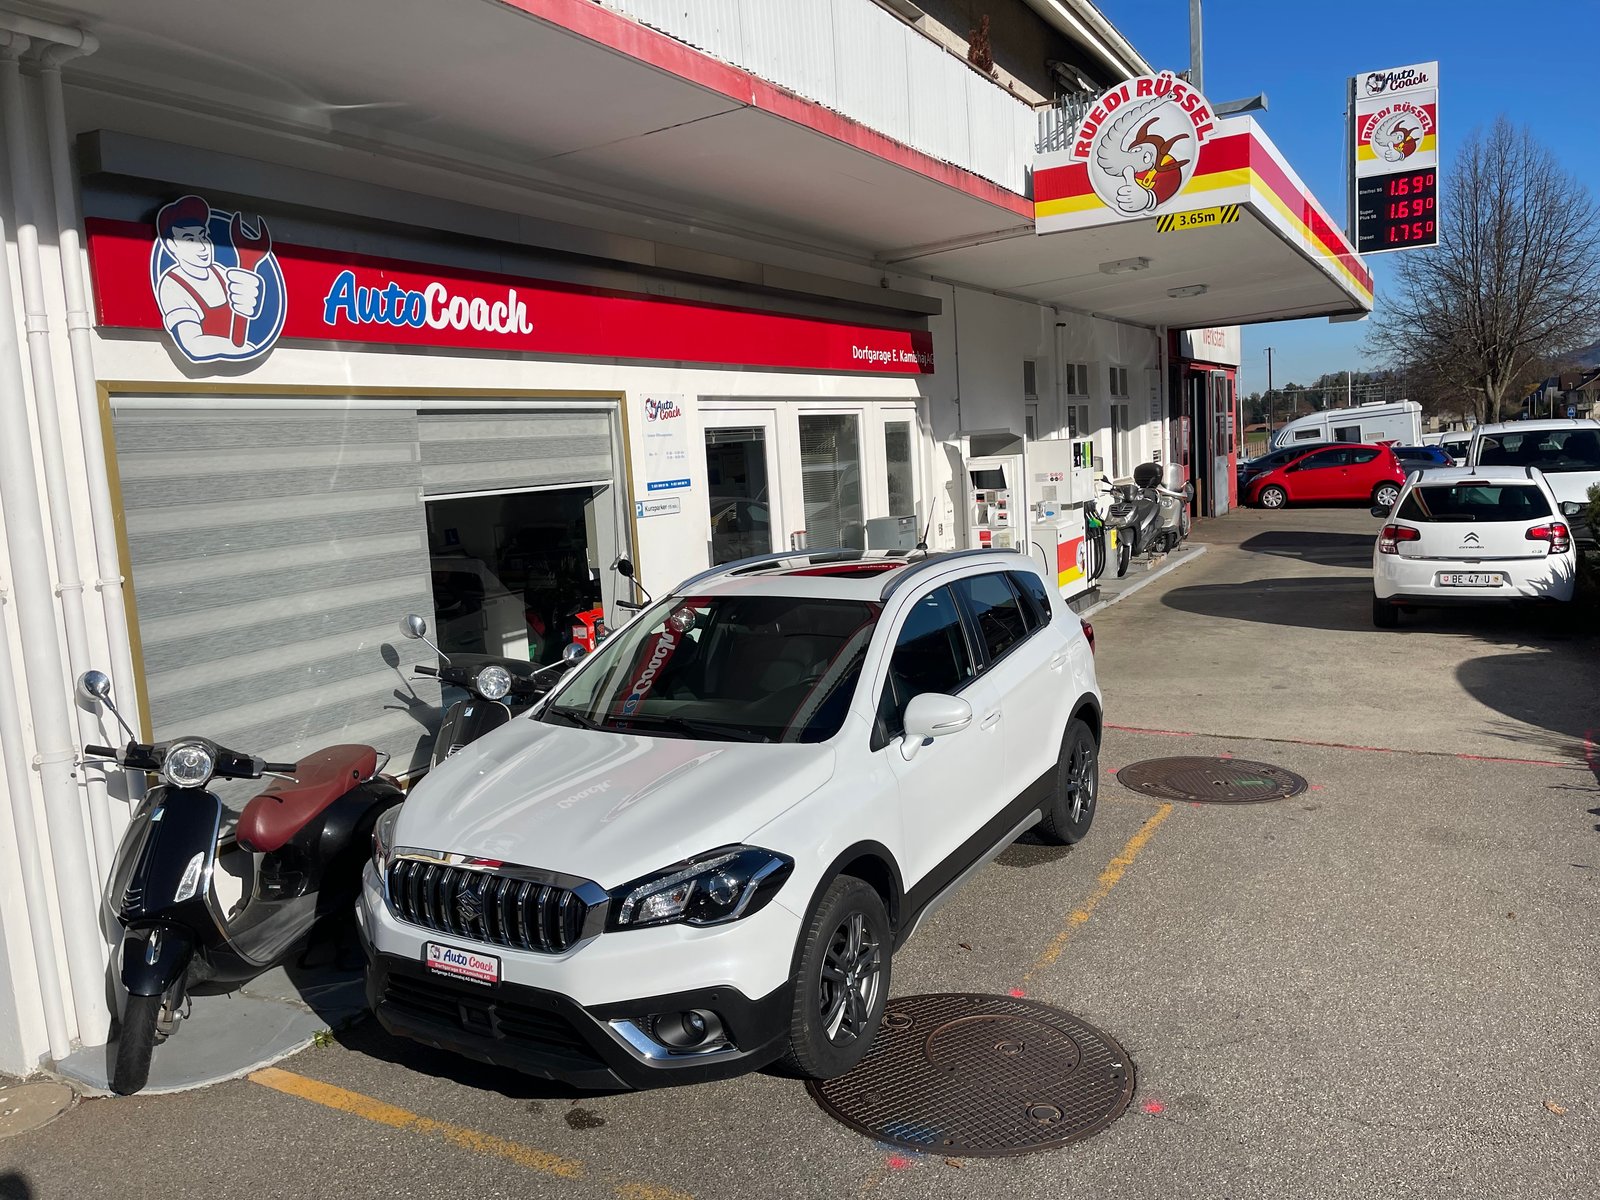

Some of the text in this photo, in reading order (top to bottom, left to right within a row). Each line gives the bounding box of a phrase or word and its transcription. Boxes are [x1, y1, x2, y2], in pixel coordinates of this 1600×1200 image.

[1386, 68, 1415, 86] Auto
[1390, 72, 1429, 91] Coach
[1074, 73, 1215, 158] RUEDI RÜSSEL
[1363, 102, 1433, 140] RUEDI RÜSSEL
[1179, 212, 1215, 226] 3.65m
[852, 345, 891, 364] Dorfgarage
[892, 349, 899, 362] E.
[656, 400, 674, 411] Auto
[660, 405, 682, 421] Coach
[1452, 575, 1490, 583] BE 47 U
[444, 949, 493, 972] Auto Coach
